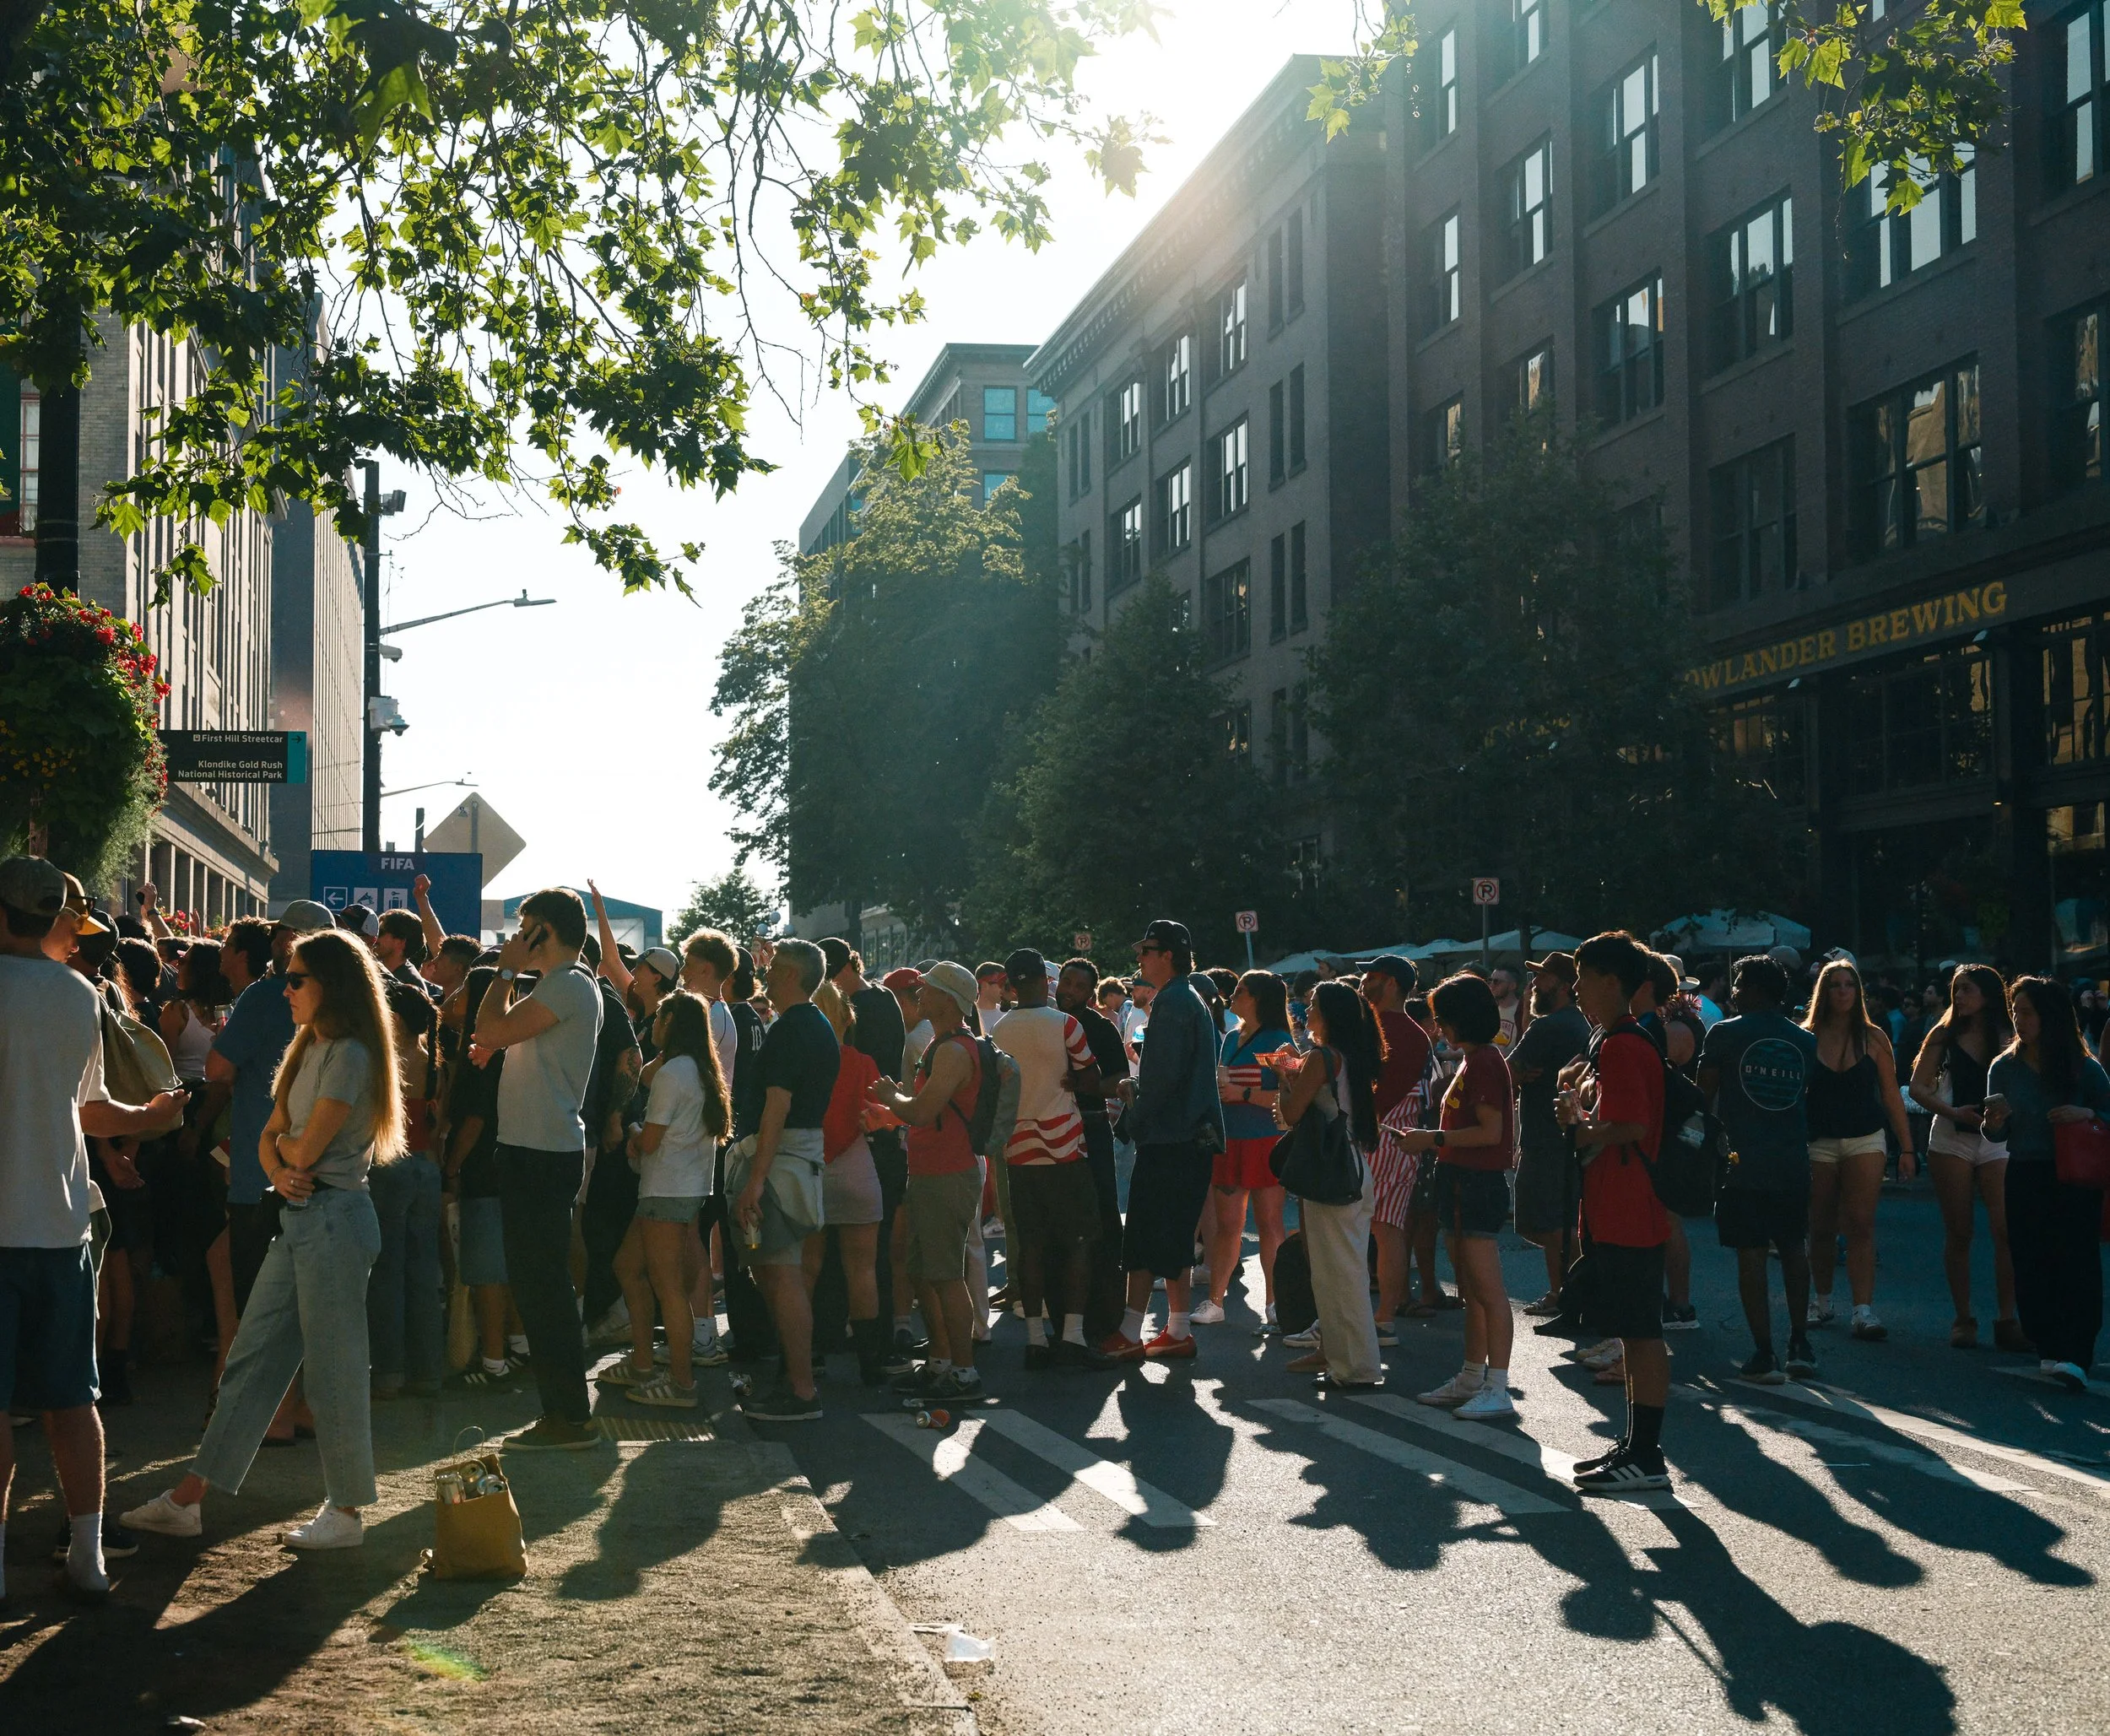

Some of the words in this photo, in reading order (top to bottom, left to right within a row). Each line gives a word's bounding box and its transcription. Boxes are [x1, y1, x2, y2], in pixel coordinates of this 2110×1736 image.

[1684, 630, 1837, 690] OWLANDER
[1846, 580, 2008, 652] BREWING
[202, 733, 223, 743] First
[225, 734, 240, 743] Hill
[241, 734, 284, 744] Streetcar
[197, 760, 237, 769] Klondike
[239, 760, 259, 769] Gold
[261, 760, 284, 770] Rush
[178, 770, 216, 778] National
[219, 770, 261, 779] Historical
[262, 771, 283, 779] Park
[381, 857, 414, 870] FIFA
[1745, 1065, 1801, 1080] O'NEILL
